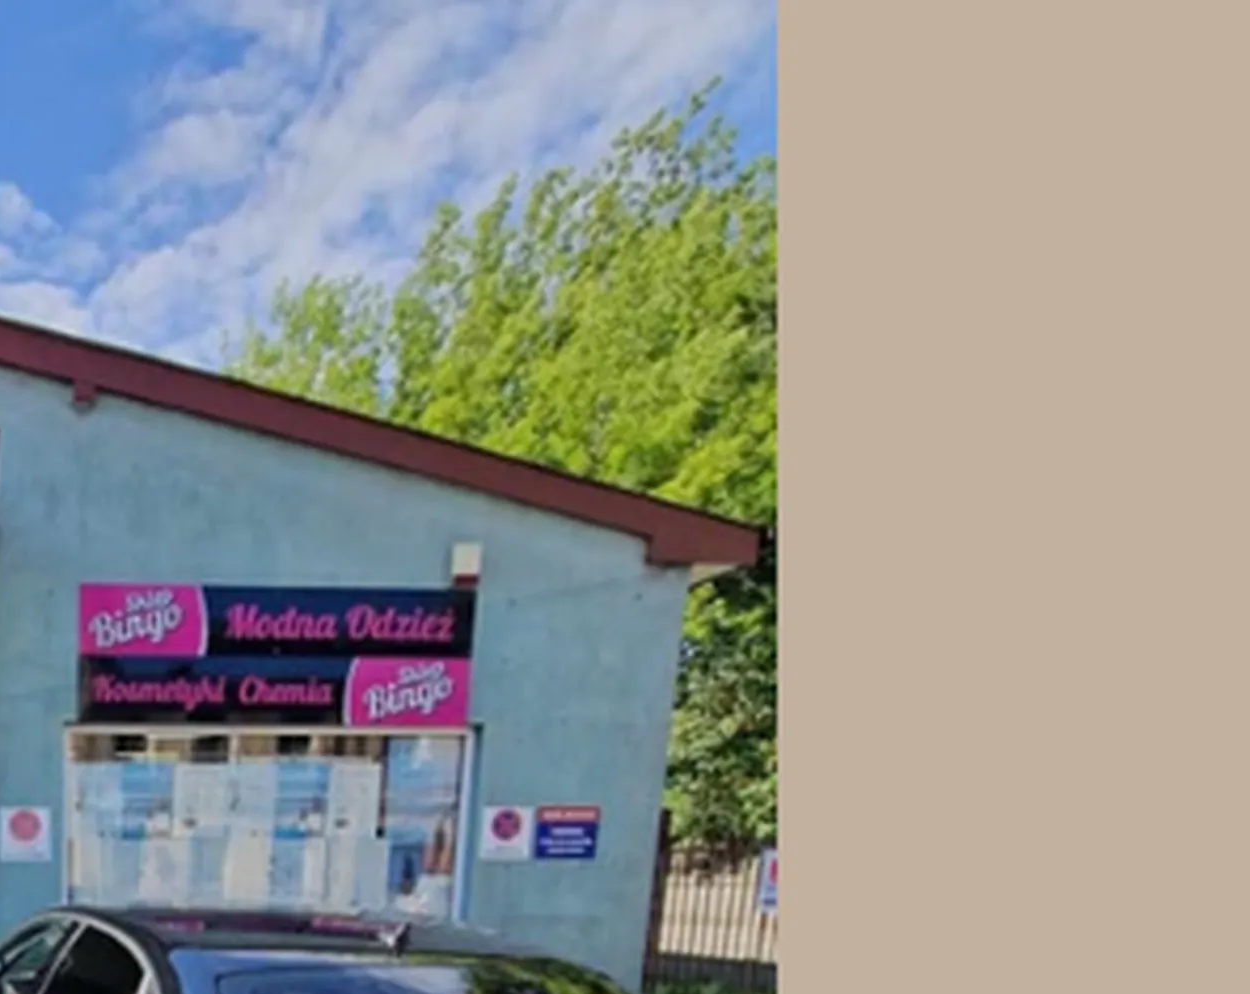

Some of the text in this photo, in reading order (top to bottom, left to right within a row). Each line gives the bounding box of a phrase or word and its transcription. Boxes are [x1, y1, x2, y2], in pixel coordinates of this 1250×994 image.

[88, 603, 183, 649] Bingo
[225, 603, 338, 641] Modna
[362, 676, 455, 719] Bingo
